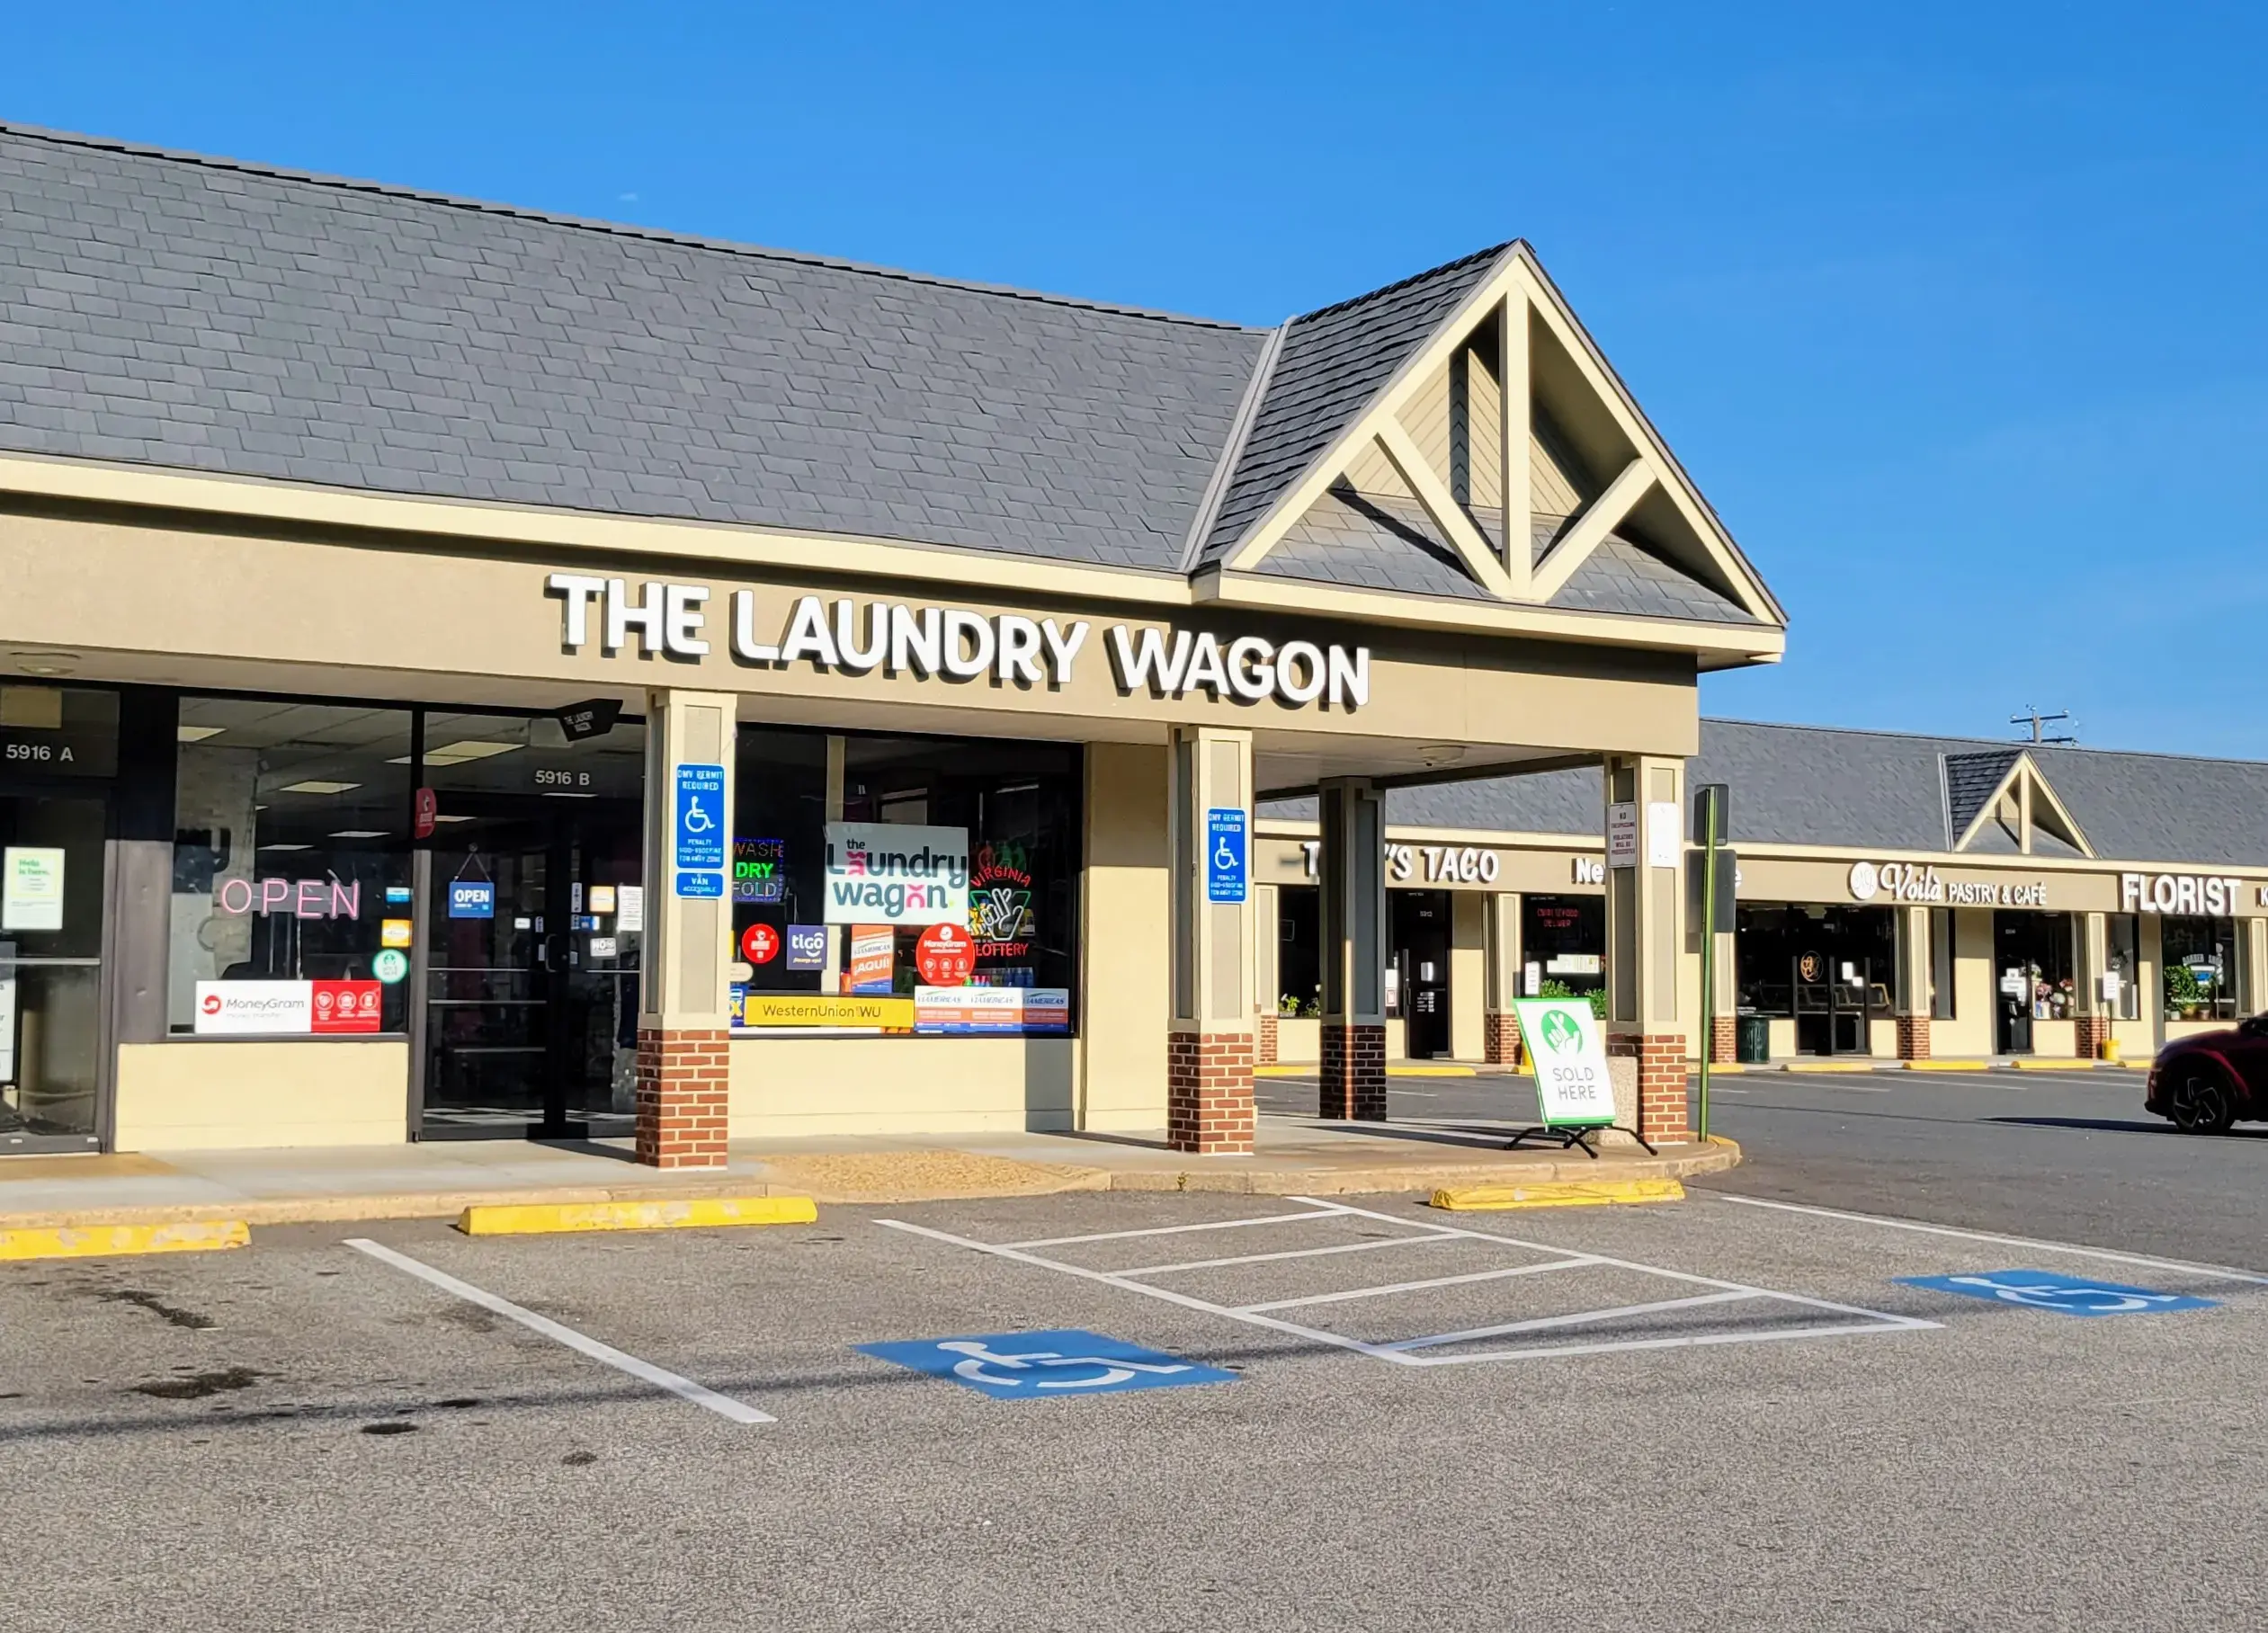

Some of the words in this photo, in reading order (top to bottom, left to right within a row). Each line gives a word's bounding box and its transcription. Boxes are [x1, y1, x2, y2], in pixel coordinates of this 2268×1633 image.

[547, 573, 710, 658] THE
[732, 588, 1090, 687] LAUNDRY
[1108, 624, 1370, 709] WAGON
[5, 744, 51, 760] 5916
[59, 746, 74, 762] A
[534, 770, 572, 785] 5916
[578, 772, 590, 786] B
[696, 770, 723, 781] PERMIT
[682, 781, 719, 791] REQUIRED
[1211, 824, 1242, 833] REQUIRED
[687, 838, 712, 846] PENALTY
[733, 842, 783, 857] WASH
[846, 838, 866, 850] the
[736, 861, 774, 879] DRY
[826, 843, 968, 889] Laundry
[1423, 846, 1500, 882] TACO
[691, 878, 710, 886] VAN
[969, 866, 1031, 888] VIRGINIA
[1880, 862, 1942, 901] Voilà
[1948, 881, 1998, 904] PASTRY
[2002, 885, 2011, 903] &
[2014, 881, 2047, 906] CAFÉ
[454, 889, 490, 903] OPEN
[732, 880, 777, 897] FOLD
[2121, 872, 2242, 916] FLORIST
[221, 879, 360, 921] OPEN
[924, 939, 967, 949] MoneyGram
[976, 941, 1029, 957] LOTTERY
[226, 997, 305, 1012] MoneyGram
[1552, 1066, 1594, 1082] SOLD
[1558, 1084, 1597, 1101] HERE
